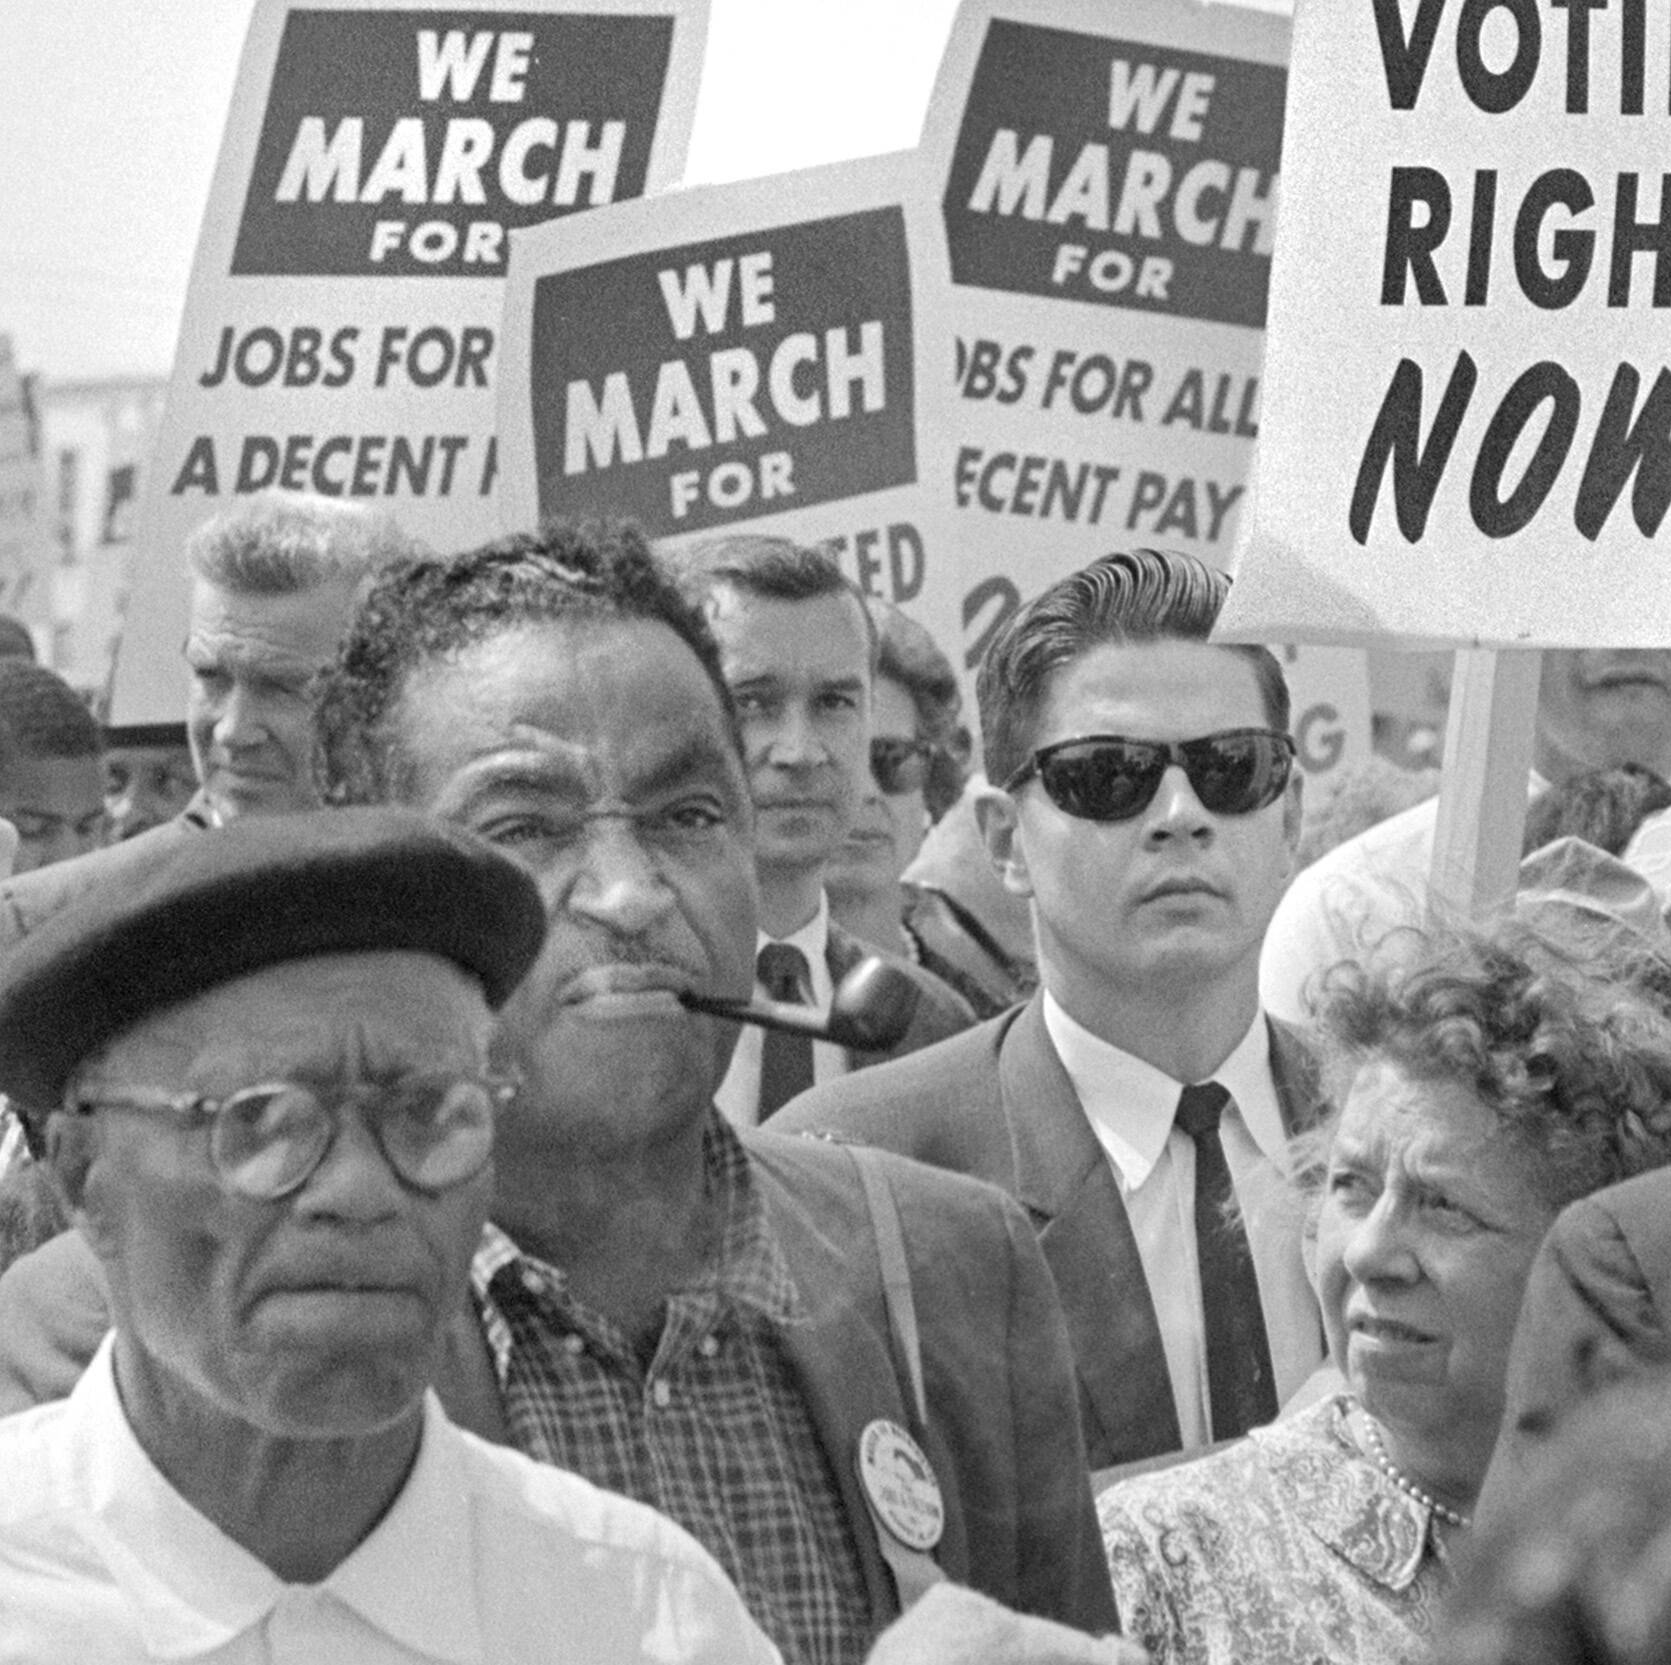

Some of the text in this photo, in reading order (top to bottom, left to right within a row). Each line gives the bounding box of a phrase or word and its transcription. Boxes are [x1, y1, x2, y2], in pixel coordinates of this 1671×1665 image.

[417, 29, 535, 103] WE
[1108, 59, 1216, 143] WE
[275, 116, 627, 206] MARCH
[969, 128, 1275, 257] MARCH
[369, 220, 504, 264] FOR
[1052, 244, 1173, 299] FOR
[657, 251, 776, 340] WE
[200, 327, 493, 387] JOBS FOR
[955, 336, 1259, 438] BS FOR ALL
[564, 320, 886, 476] MARCH
[171, 437, 218, 495] A
[236, 437, 467, 496] DECENT
[670, 451, 796, 519] FOR
[1127, 473, 1246, 542] PAY
[830, 522, 926, 604] ED
